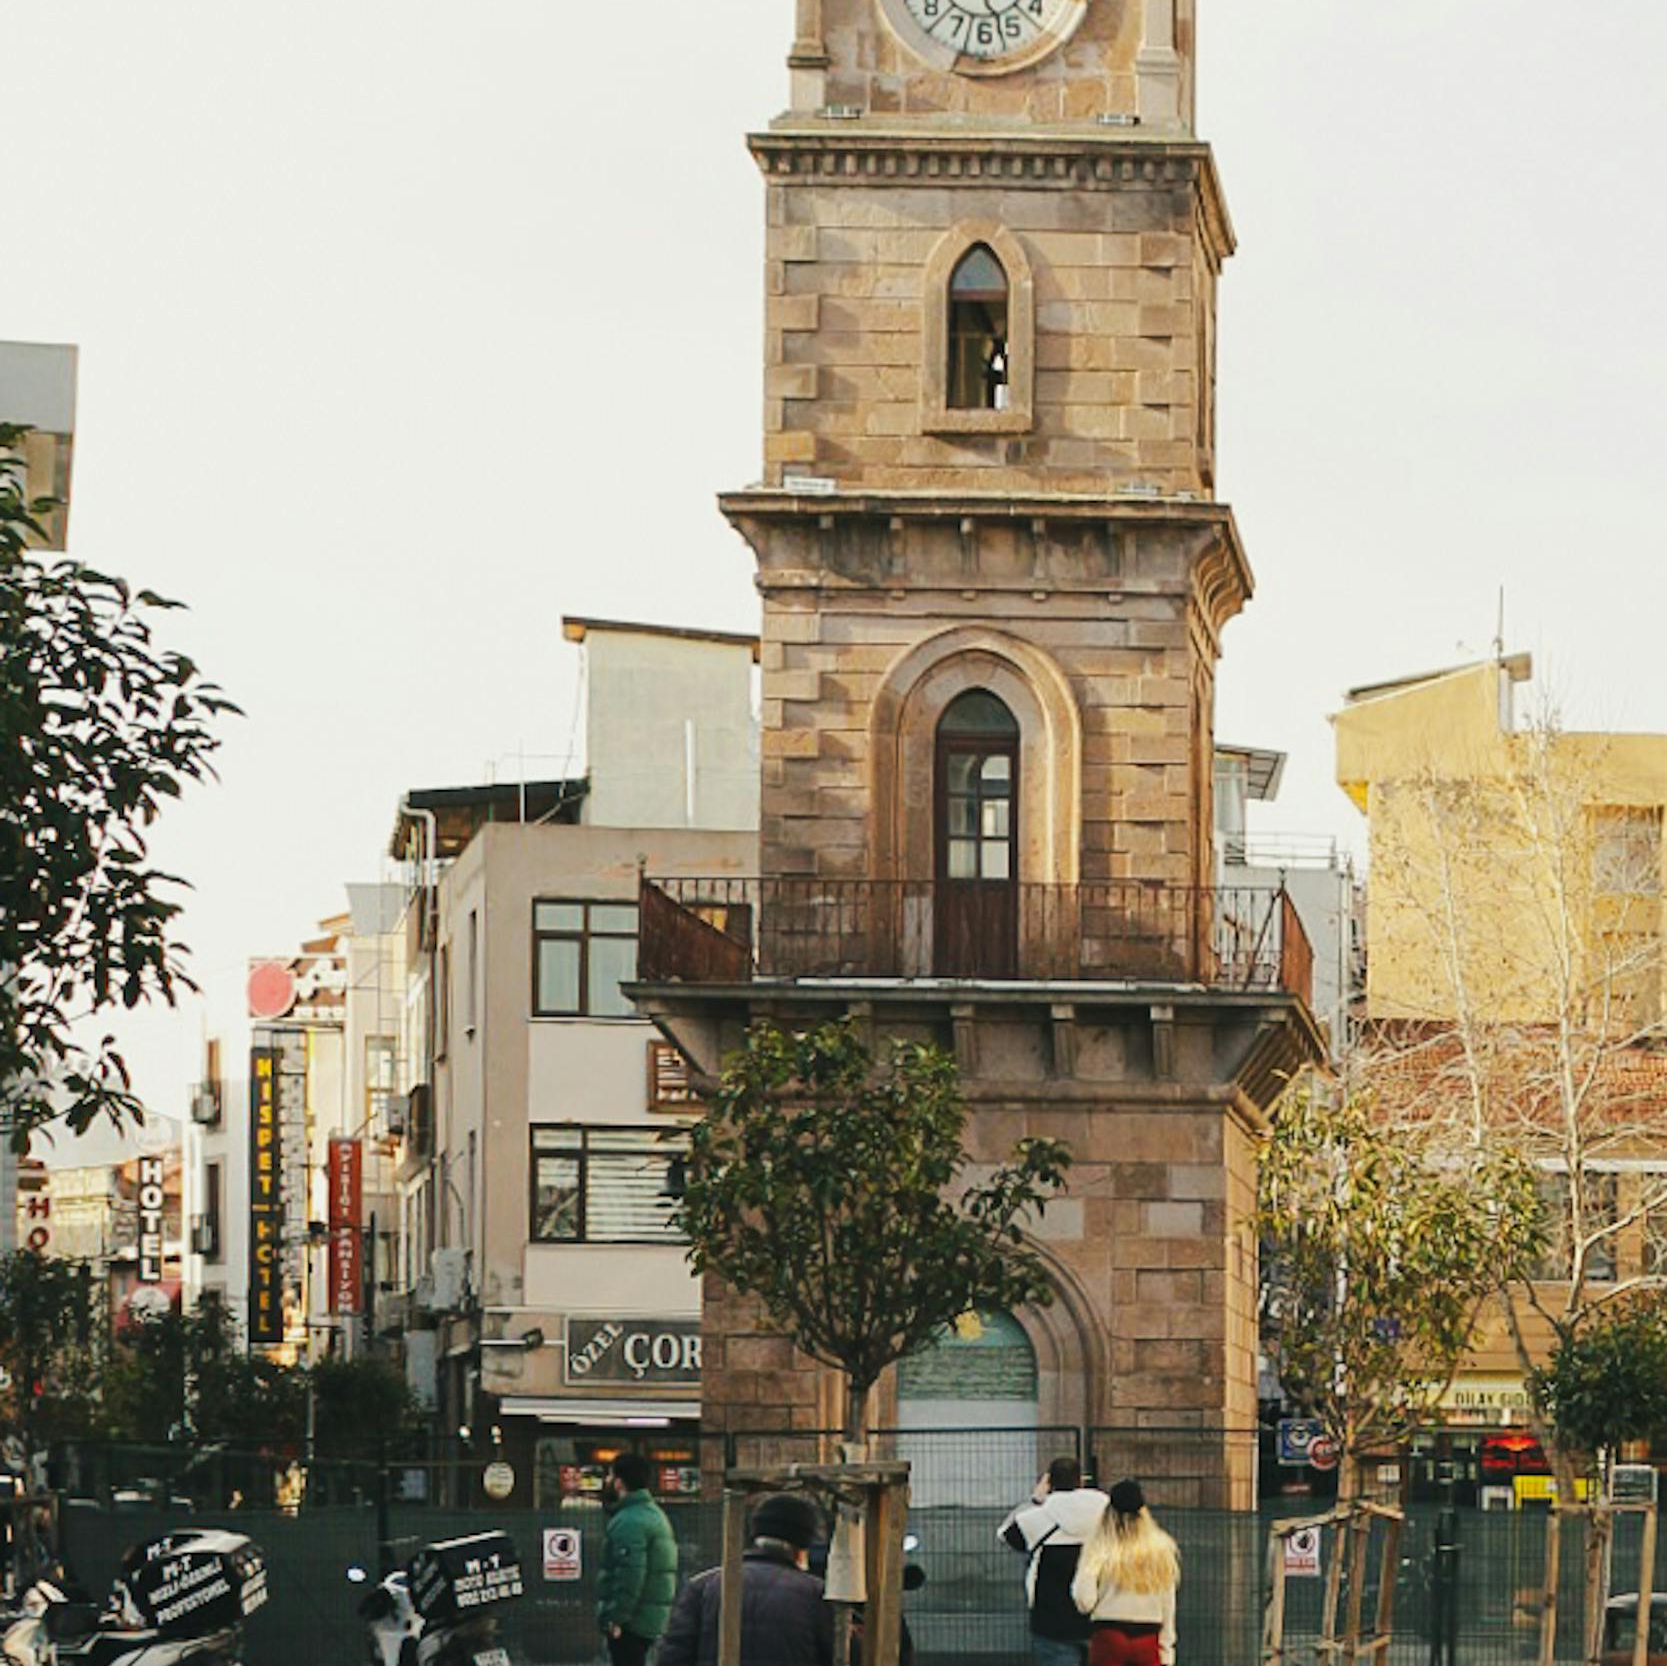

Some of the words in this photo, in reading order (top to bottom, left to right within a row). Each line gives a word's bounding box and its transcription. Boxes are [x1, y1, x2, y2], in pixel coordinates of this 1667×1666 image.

[950, 16, 964, 37] 7
[976, 23, 993, 44] 6
[1004, 16, 1021, 37] 5
[140, 1159, 163, 1281] HOTEL
[256, 1220, 273, 1332] HOTEL
[570, 1322, 624, 1374] ÖZEL
